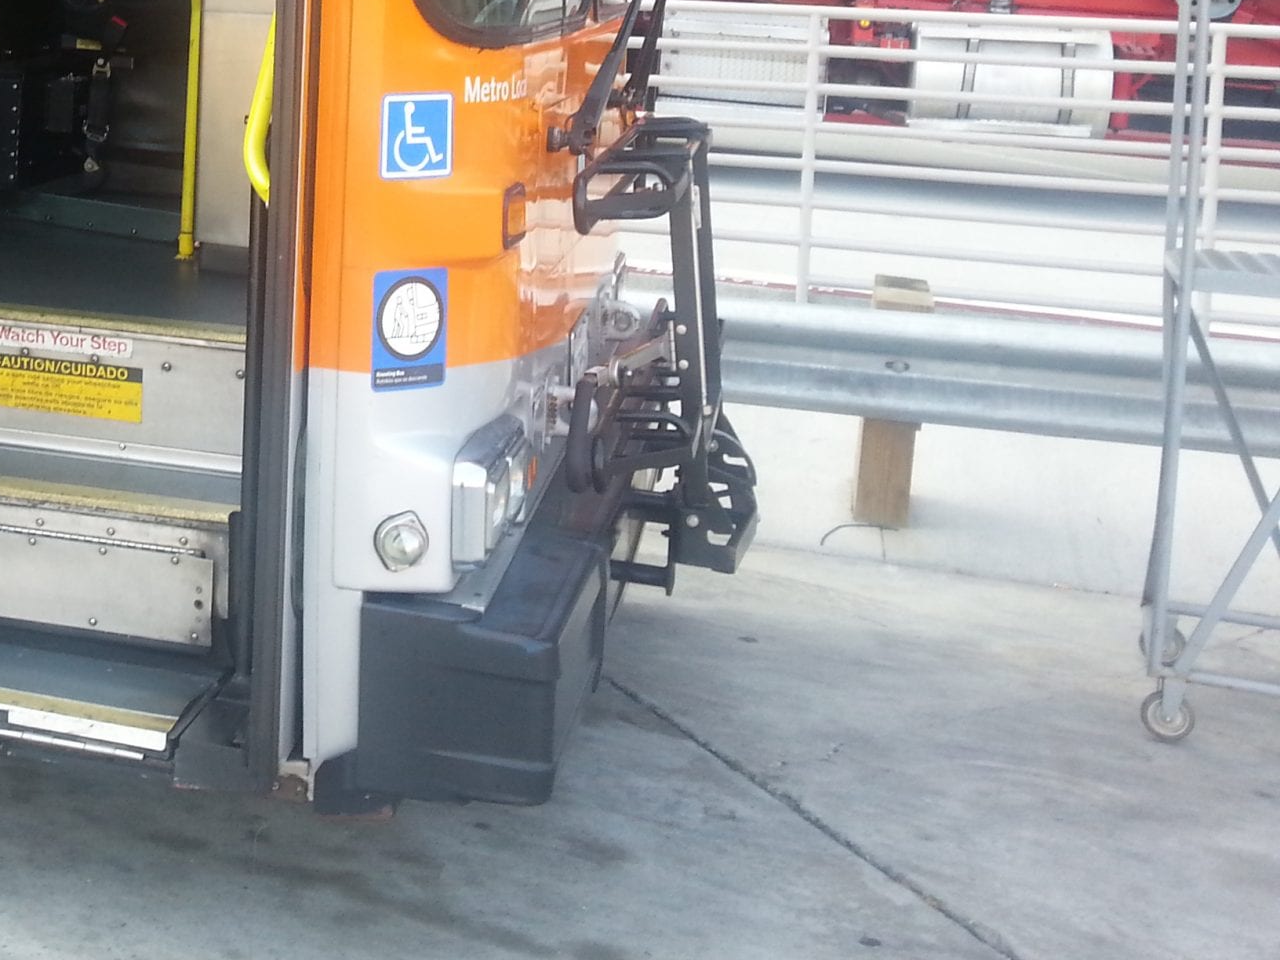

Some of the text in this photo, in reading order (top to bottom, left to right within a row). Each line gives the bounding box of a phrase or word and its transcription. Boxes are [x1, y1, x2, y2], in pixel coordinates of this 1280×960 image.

[464, 75, 509, 104] Metro
[51, 331, 88, 350] Your
[90, 335, 128, 354] Step
